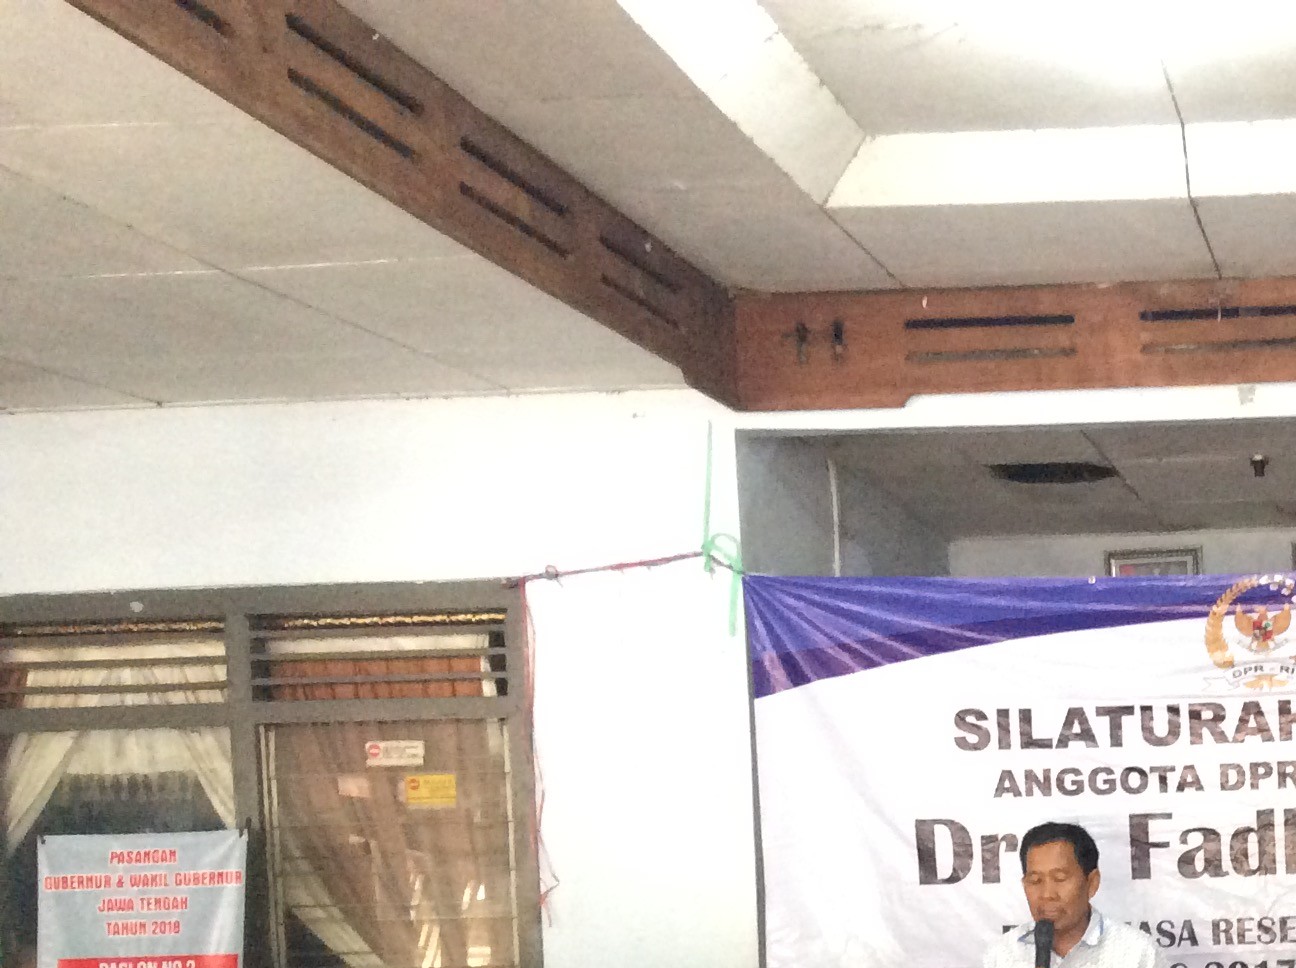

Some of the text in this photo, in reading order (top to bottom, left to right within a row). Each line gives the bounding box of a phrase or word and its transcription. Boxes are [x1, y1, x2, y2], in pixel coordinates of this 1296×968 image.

[1280, 665, 1295, 675] RI
[993, 765, 1205, 798] ANGGOTA
[109, 849, 177, 864] PASANGAN
[914, 818, 1018, 885] Dr
[44, 871, 242, 890] GUBERNUR & WAKIL GUBERNUR
[97, 896, 188, 912] JAWA TENGAH
[106, 920, 181, 936] TAHUN 2018
[1126, 919, 1199, 948] SA
